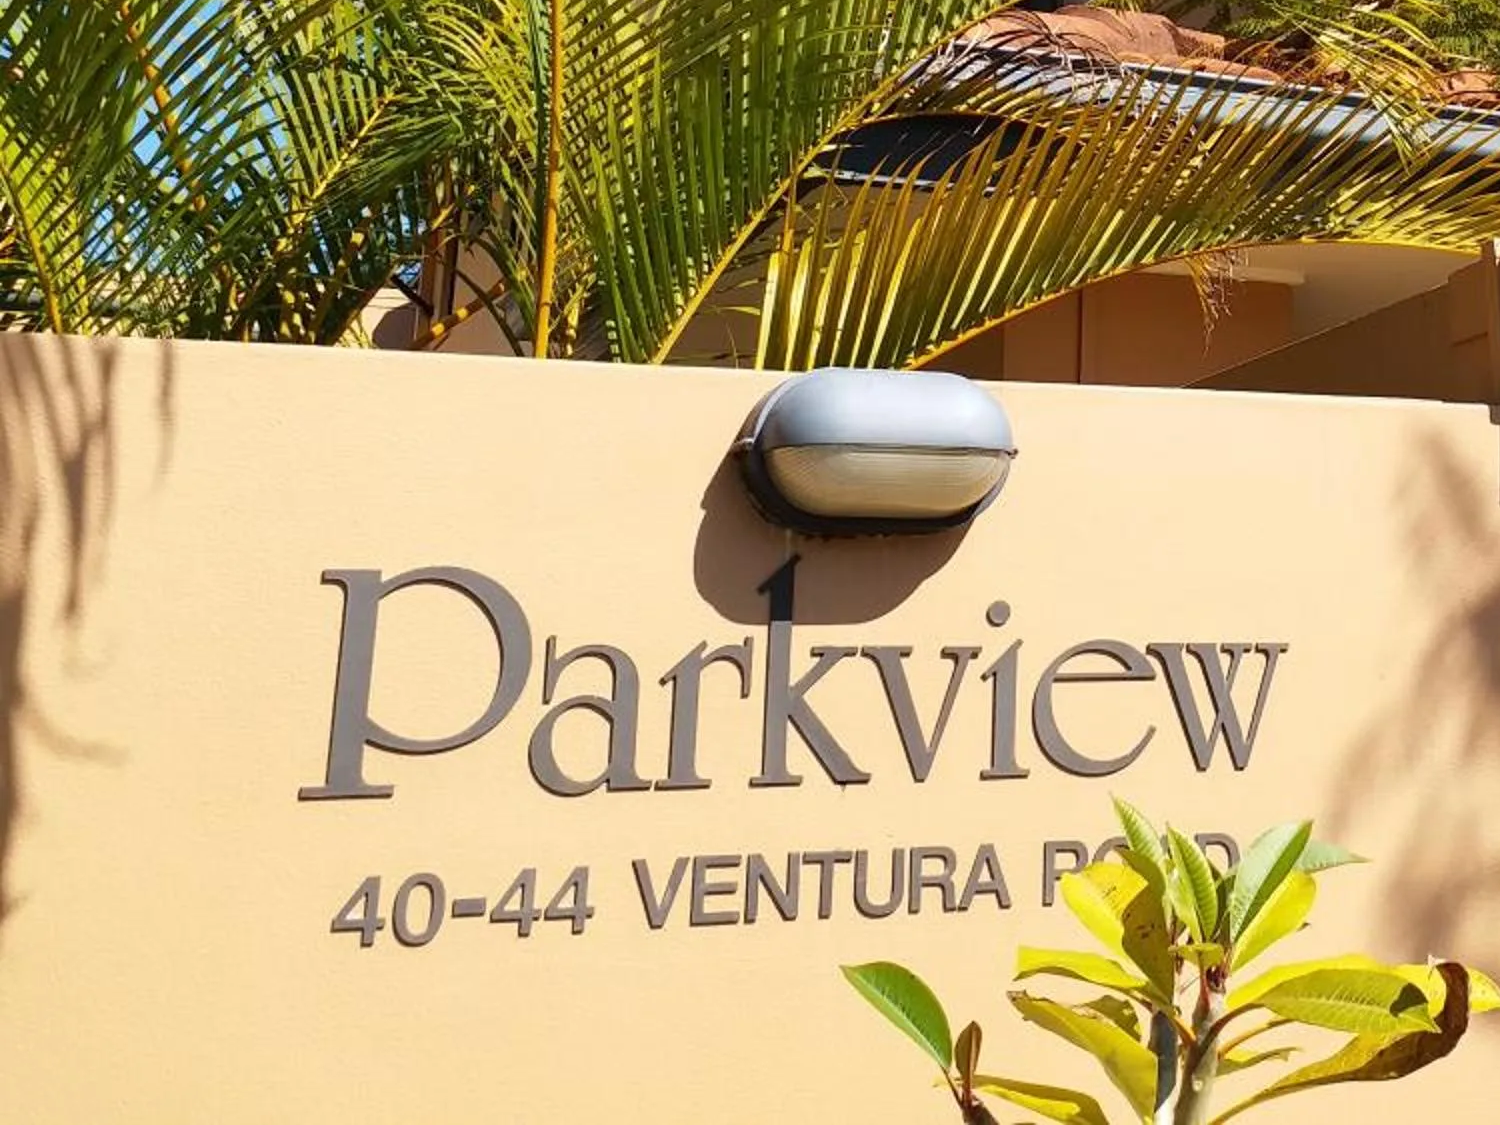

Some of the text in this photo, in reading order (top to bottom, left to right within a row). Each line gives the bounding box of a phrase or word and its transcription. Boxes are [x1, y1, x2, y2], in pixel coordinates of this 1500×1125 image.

[298, 554, 1288, 801] Parkview
[330, 865, 596, 949] 40-44
[631, 842, 1012, 931] VENTURA
